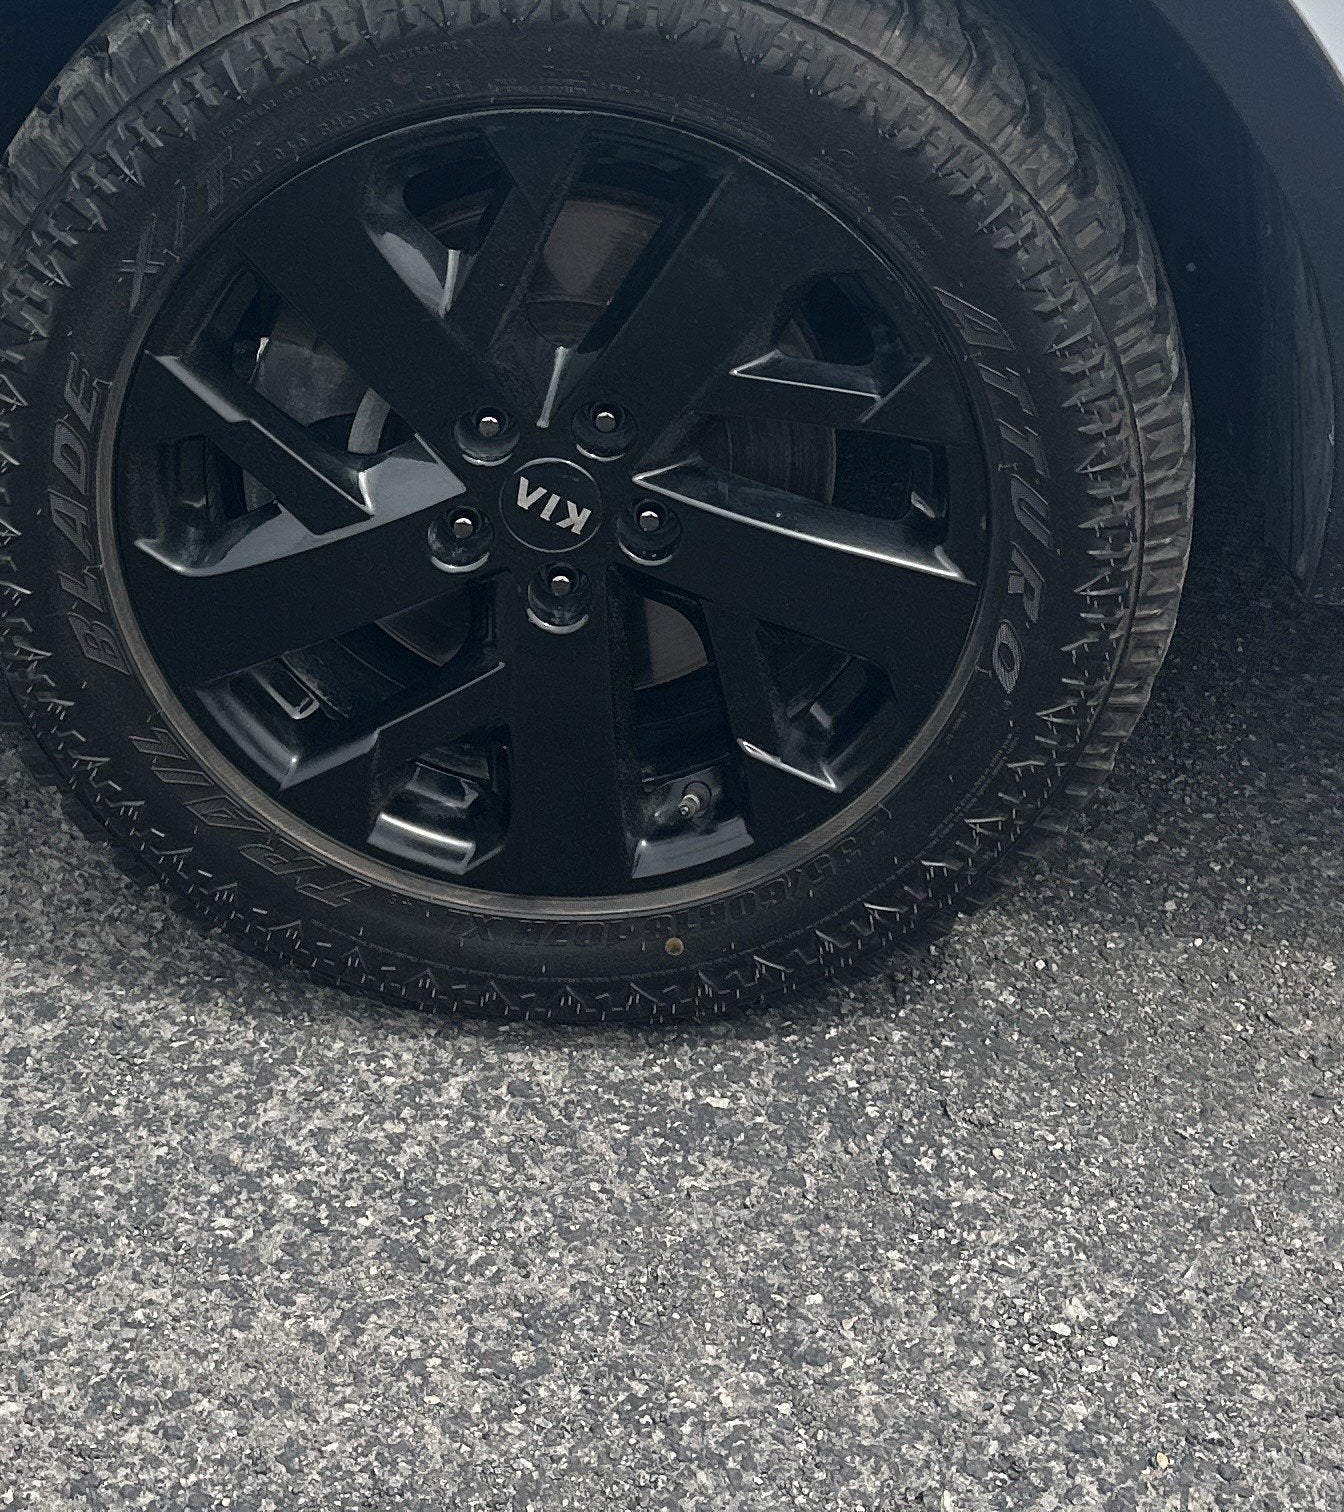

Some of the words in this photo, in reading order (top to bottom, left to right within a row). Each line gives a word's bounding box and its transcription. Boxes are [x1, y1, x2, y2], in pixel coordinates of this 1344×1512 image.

[229, 159, 263, 190] DOT
[47, 350, 131, 673] BLADE
[517, 476, 592, 535] KIA
[932, 286, 1055, 696] ATTURO
[127, 729, 371, 912] TRAIL
